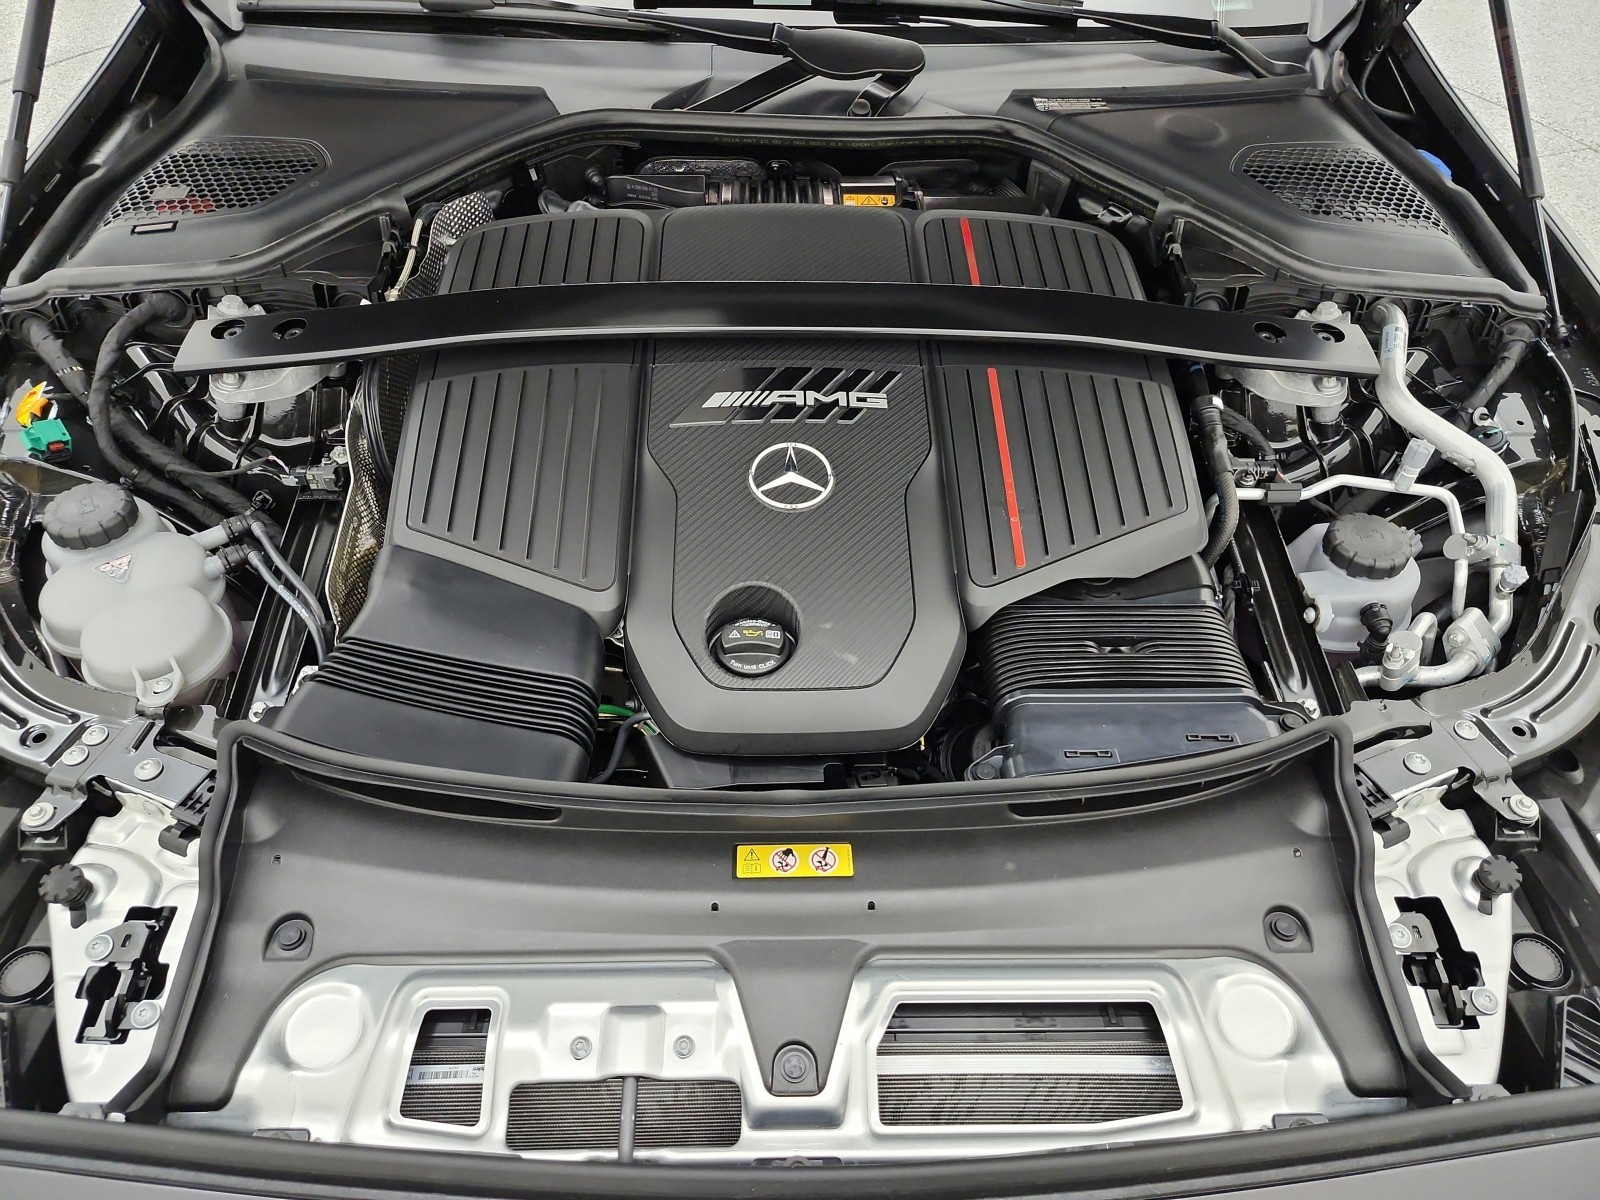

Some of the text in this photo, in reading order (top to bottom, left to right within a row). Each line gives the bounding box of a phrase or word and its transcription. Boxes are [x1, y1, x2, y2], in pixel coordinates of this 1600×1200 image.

[761, 390, 889, 409] AMG
[730, 659, 742, 668] Turn
[758, 660, 776, 669] CLICK
